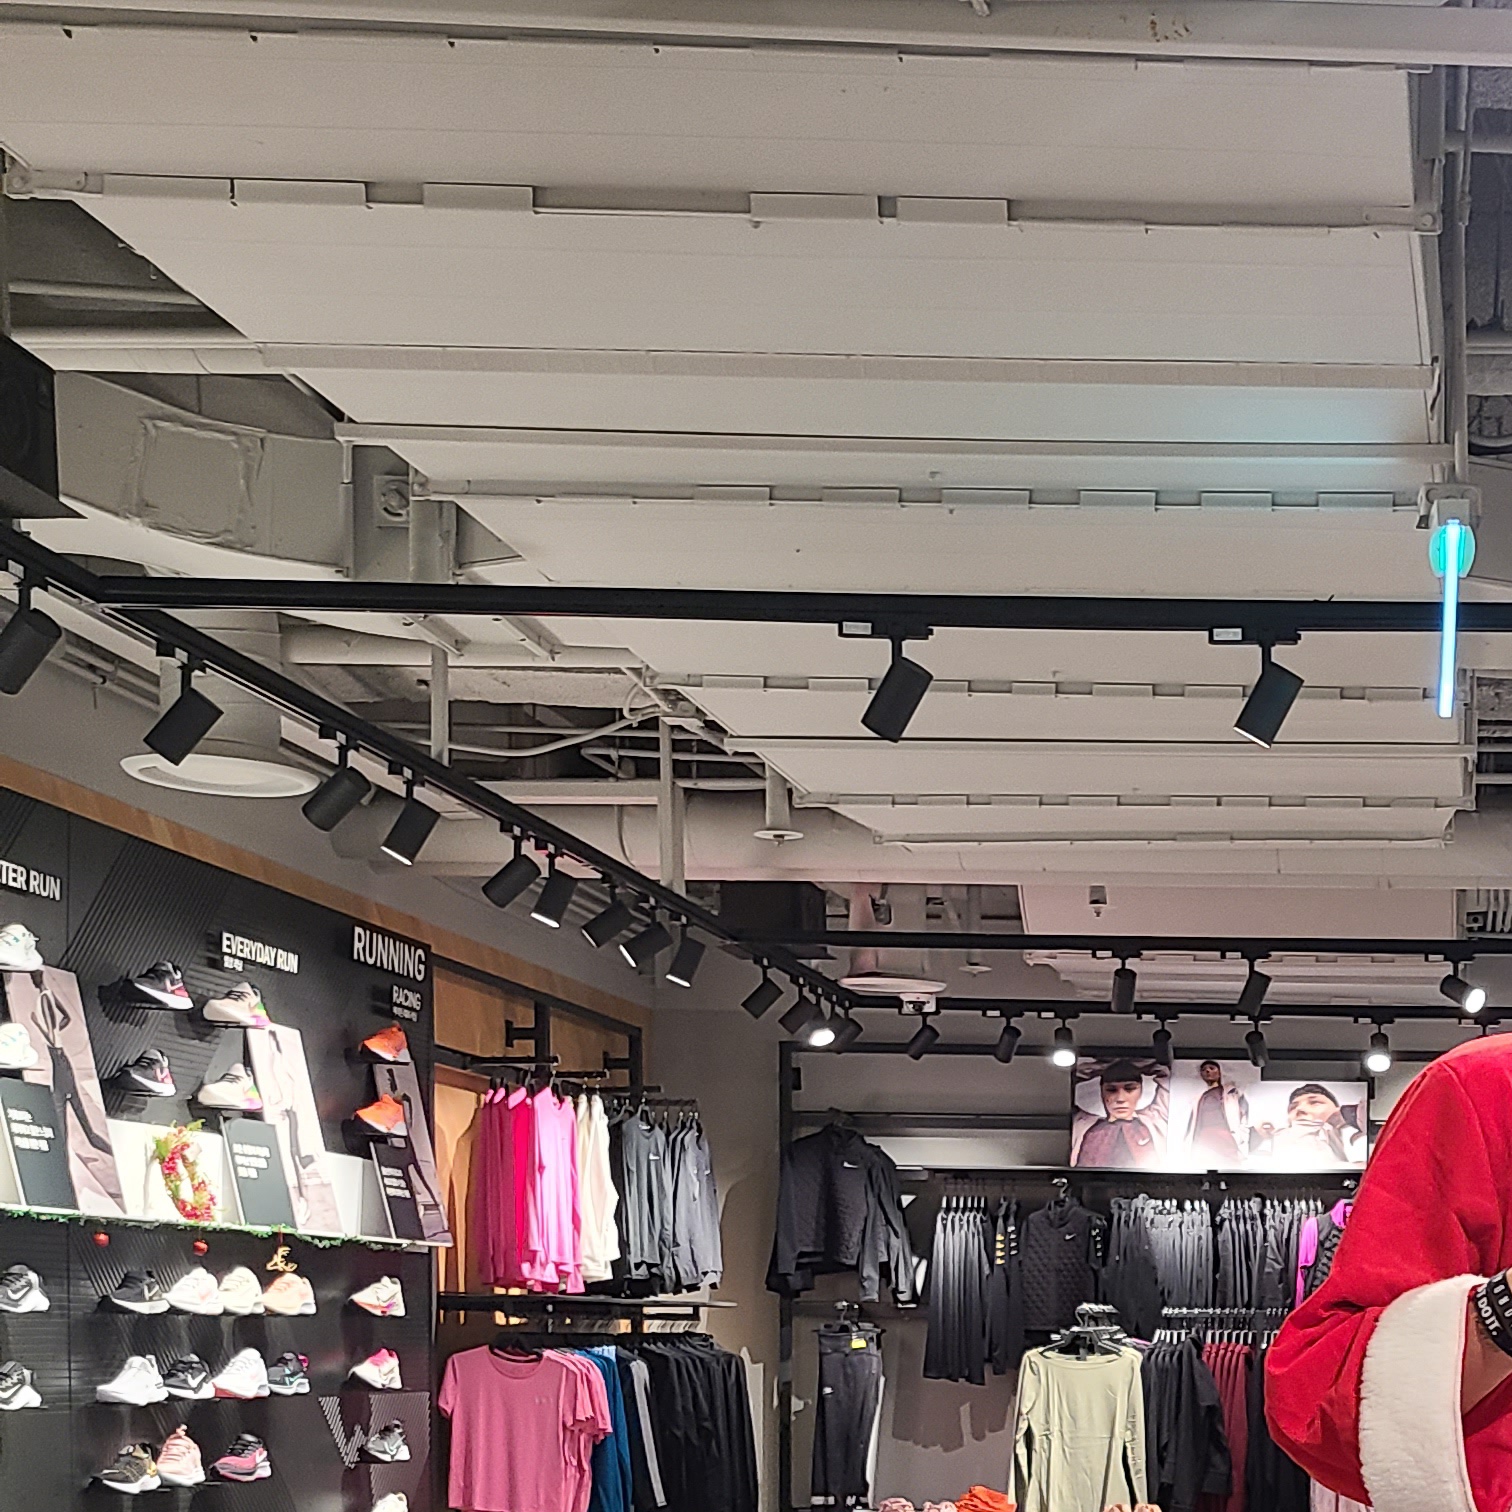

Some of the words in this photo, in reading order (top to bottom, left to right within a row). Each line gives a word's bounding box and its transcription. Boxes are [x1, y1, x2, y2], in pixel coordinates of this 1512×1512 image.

[0, 859, 28, 891] TER
[29, 869, 61, 901] RUN
[222, 931, 276, 967] EVERYDAY
[276, 948, 299, 974] RUN
[353, 925, 426, 982] RUNNING
[392, 984, 422, 1011] RACING
